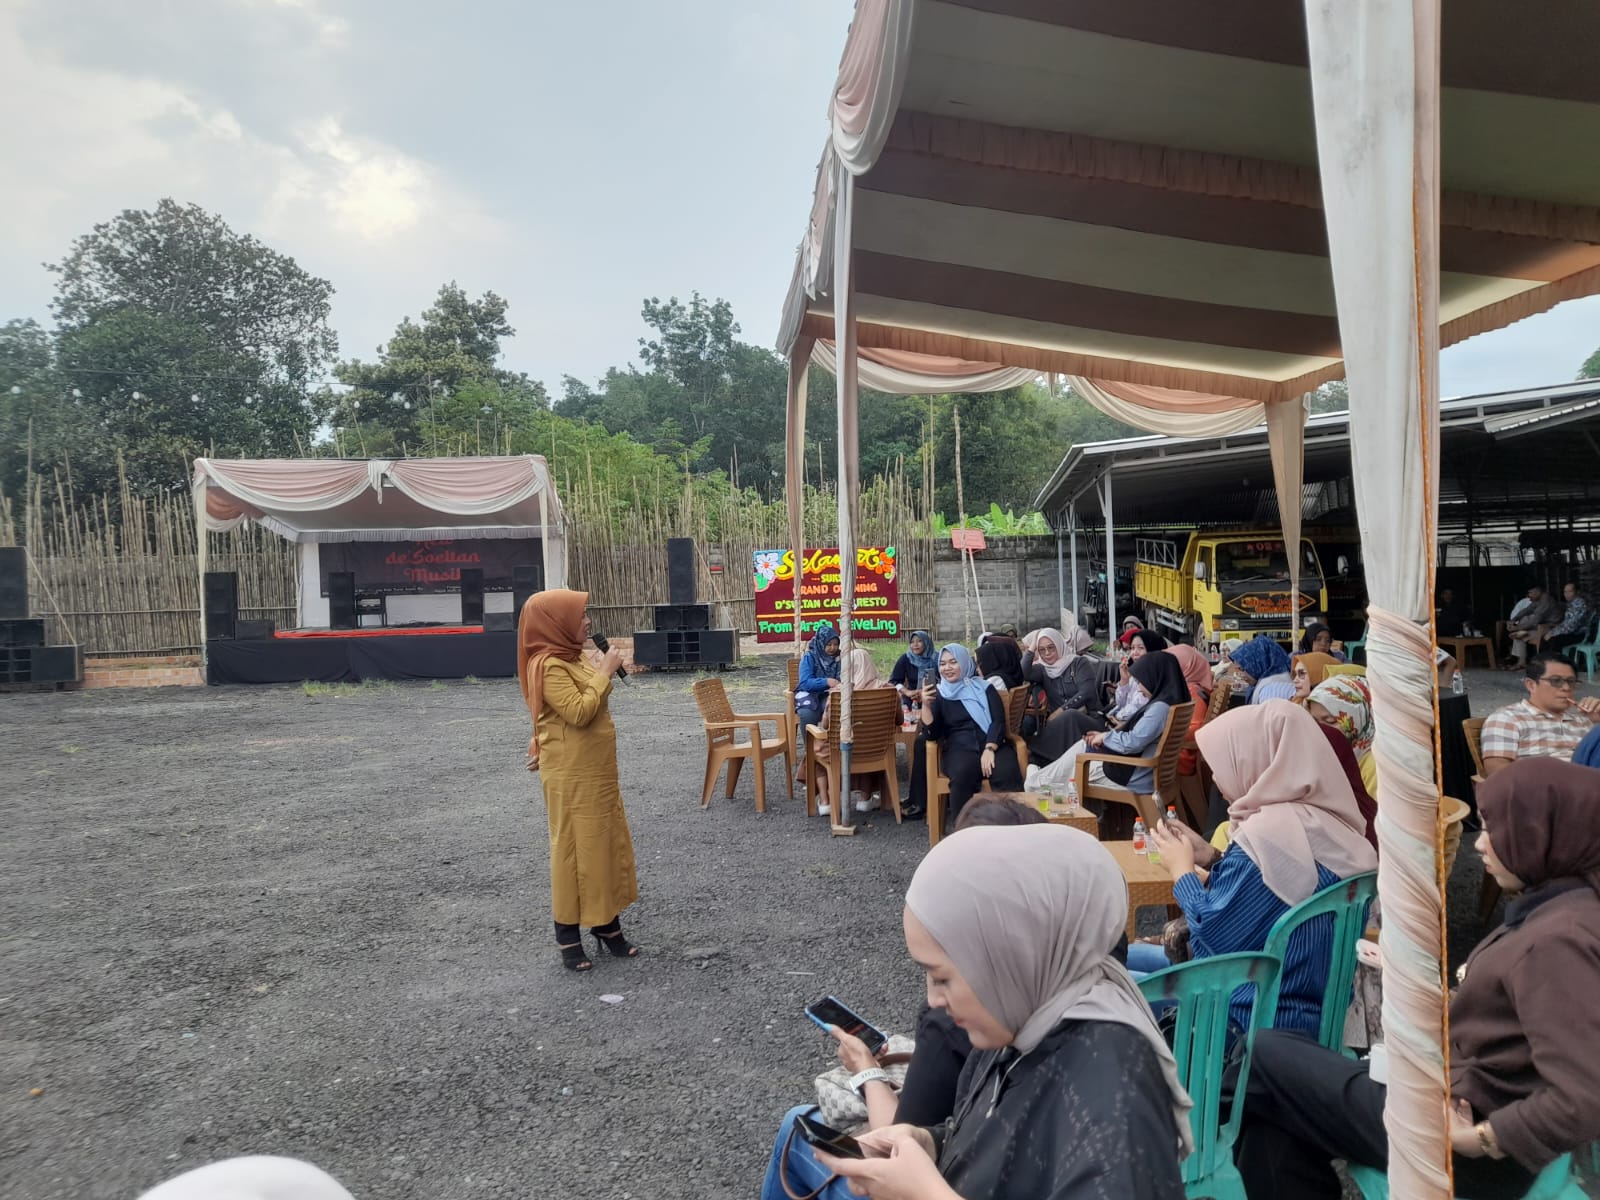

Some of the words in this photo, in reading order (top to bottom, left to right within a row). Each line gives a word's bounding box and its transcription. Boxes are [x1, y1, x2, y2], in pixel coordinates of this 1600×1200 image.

[403, 567, 462, 584] Musi
[833, 583, 878, 593] ONING
[774, 599, 821, 610] D'SUTAN
[856, 597, 888, 607] RESTO
[758, 621, 793, 633] From
